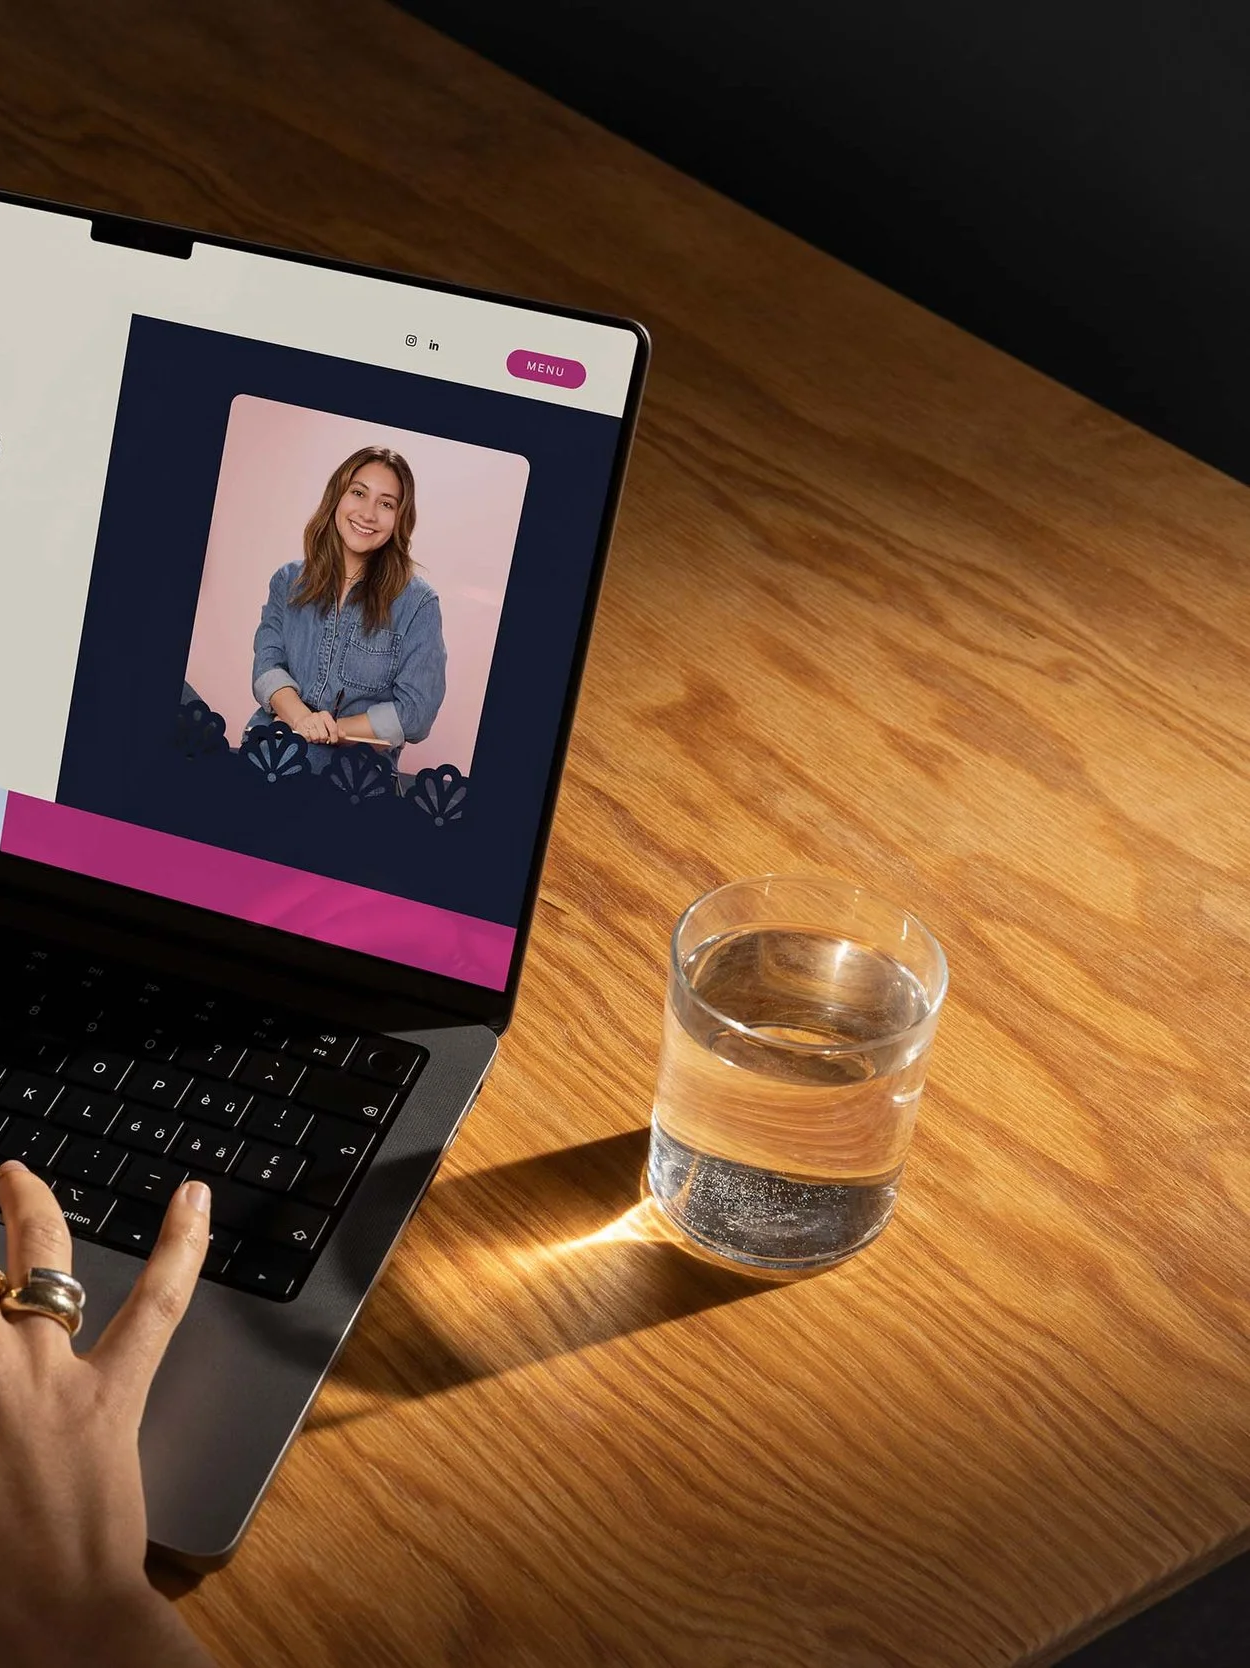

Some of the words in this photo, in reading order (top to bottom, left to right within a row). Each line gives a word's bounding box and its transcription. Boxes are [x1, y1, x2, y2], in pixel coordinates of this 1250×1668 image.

[526, 360, 565, 377] MENU
[28, 1005, 41, 1016] 8
[86, 1022, 98, 1033] 9
[312, 1048, 328, 1057] F12
[152, 1079, 166, 1090] P
[22, 1087, 38, 1100] K
[82, 1105, 91, 1118] L
[224, 1101, 236, 1113] ü
[130, 1120, 142, 1132] é
[154, 1128, 166, 1139] ö
[215, 1146, 227, 1158] ä
[261, 1169, 272, 1179] $
